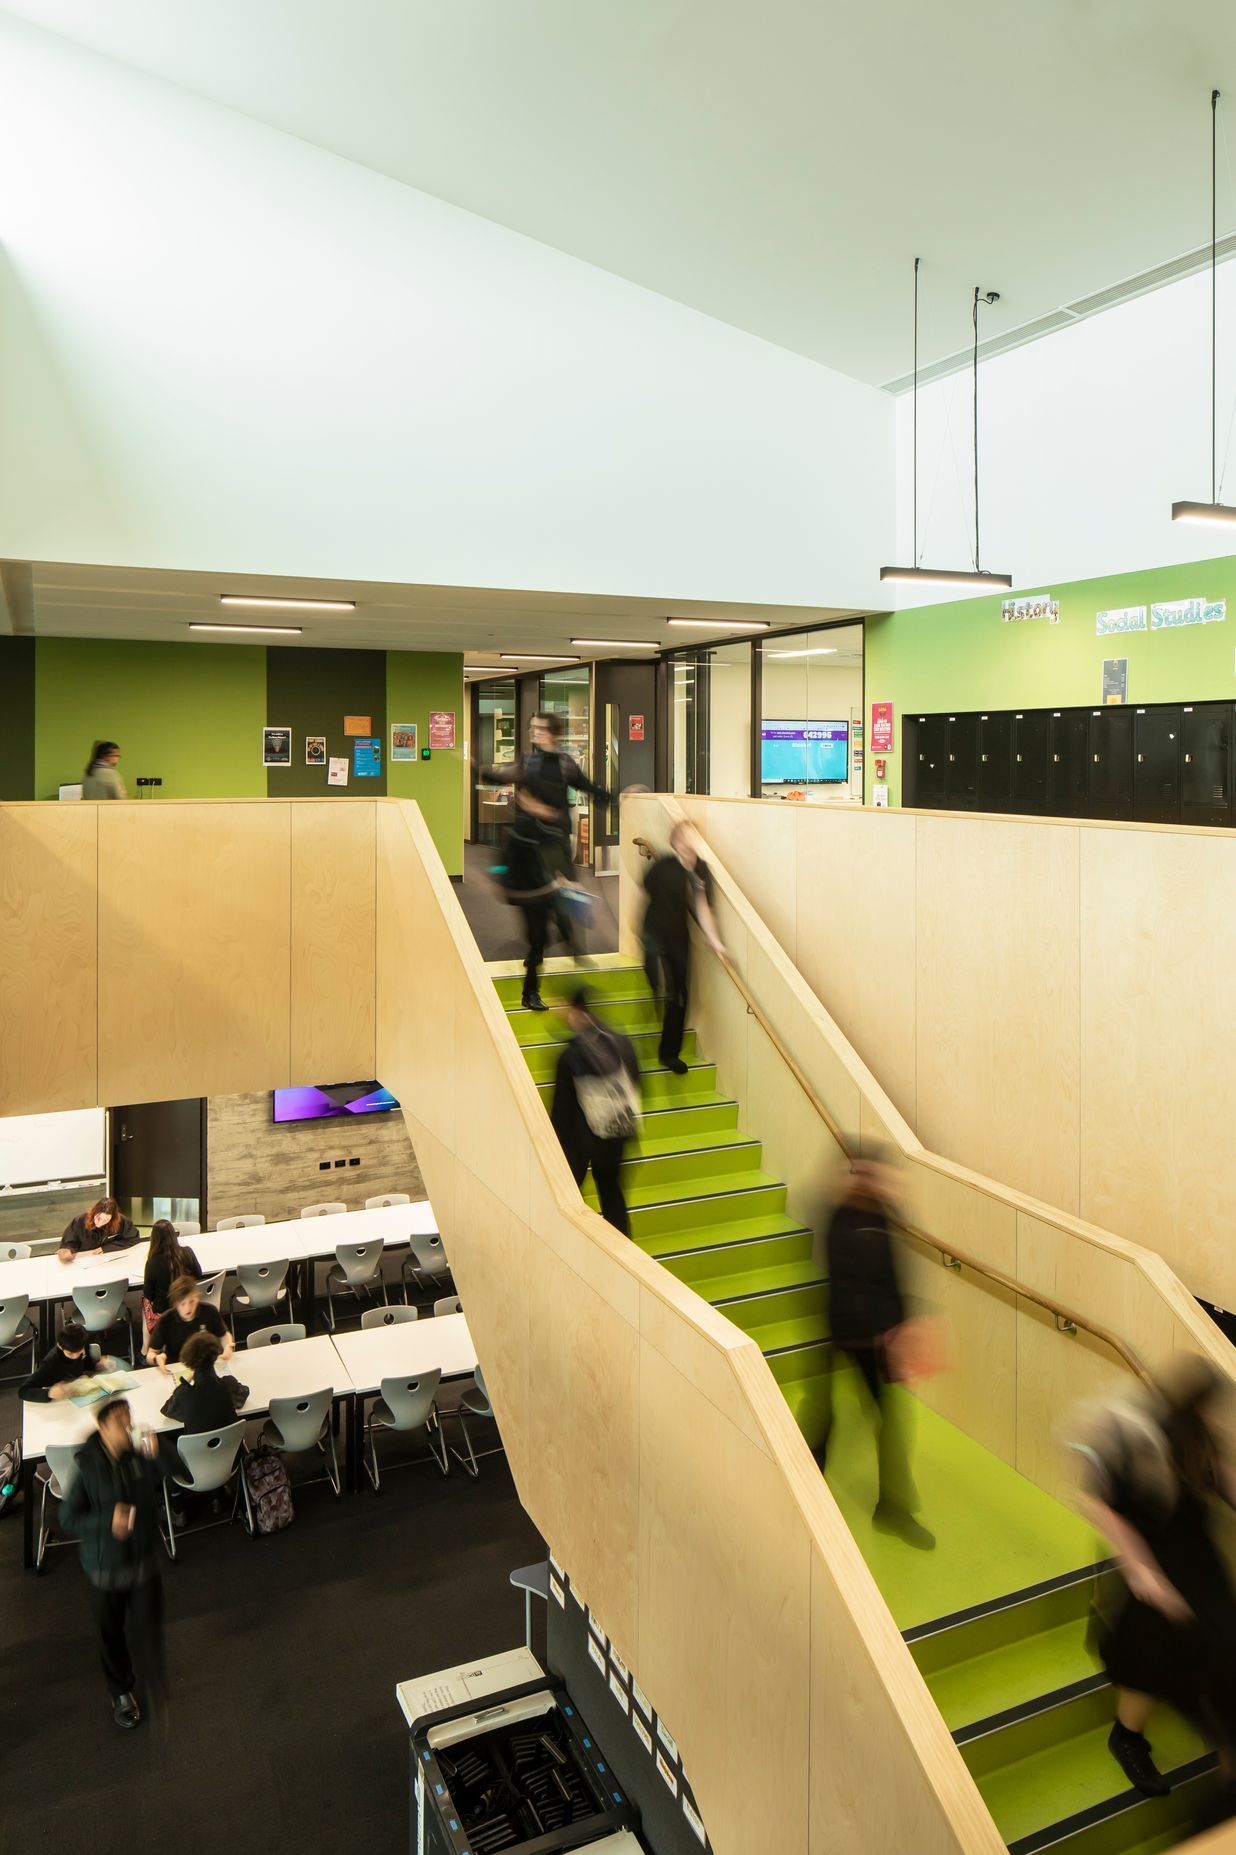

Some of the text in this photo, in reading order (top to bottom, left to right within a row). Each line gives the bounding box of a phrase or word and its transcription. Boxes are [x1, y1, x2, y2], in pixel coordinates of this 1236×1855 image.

[1002, 601, 1058, 623] History
[1097, 600, 1224, 633] Social Studies
